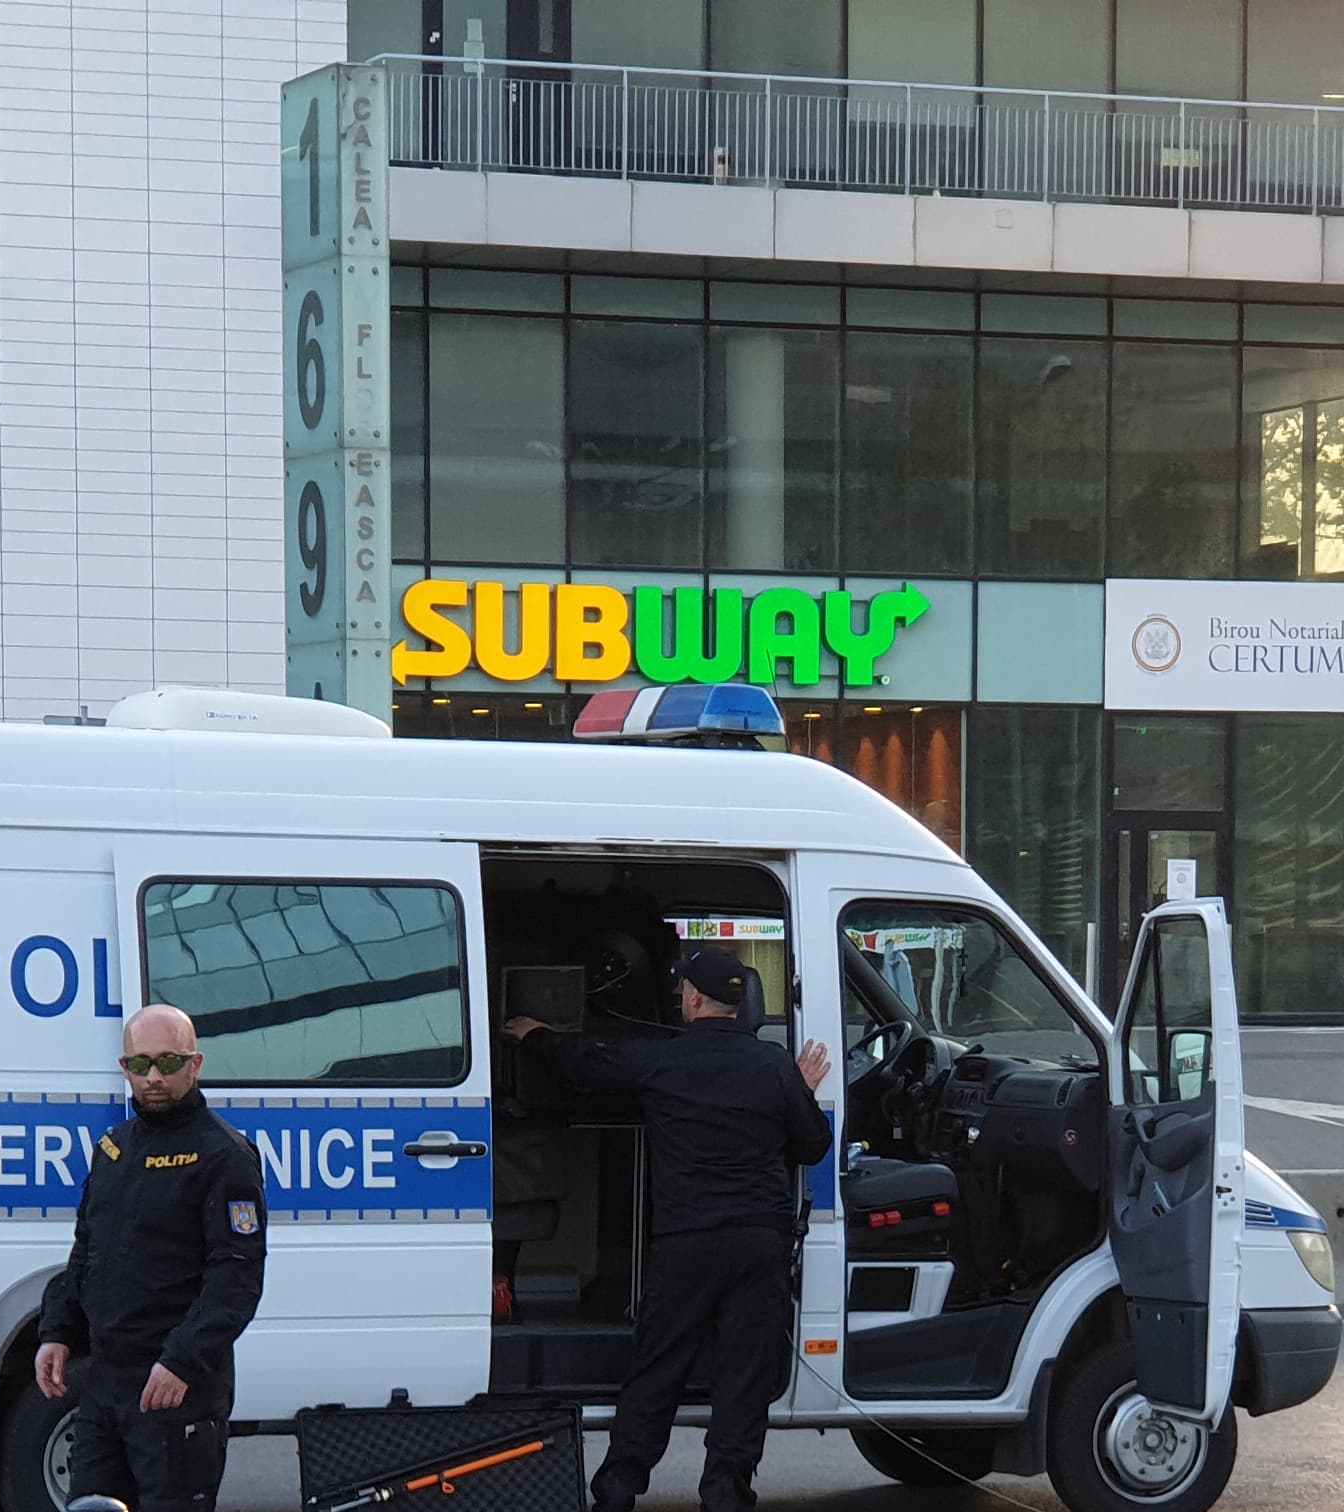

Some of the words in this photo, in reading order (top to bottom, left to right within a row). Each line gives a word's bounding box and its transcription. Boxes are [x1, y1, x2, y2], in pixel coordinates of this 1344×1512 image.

[352, 97, 372, 230] CALEA
[297, 97, 326, 700] 169
[392, 579, 931, 687] SUBWAY
[1210, 616, 1260, 639] Birou
[1270, 618, 1344, 640] Notarial
[1208, 644, 1344, 674] CERTUM
[737, 923, 784, 935] SUBWAY
[145, 1152, 198, 1169] POLITIA
[238, 1127, 396, 1189] NICE
